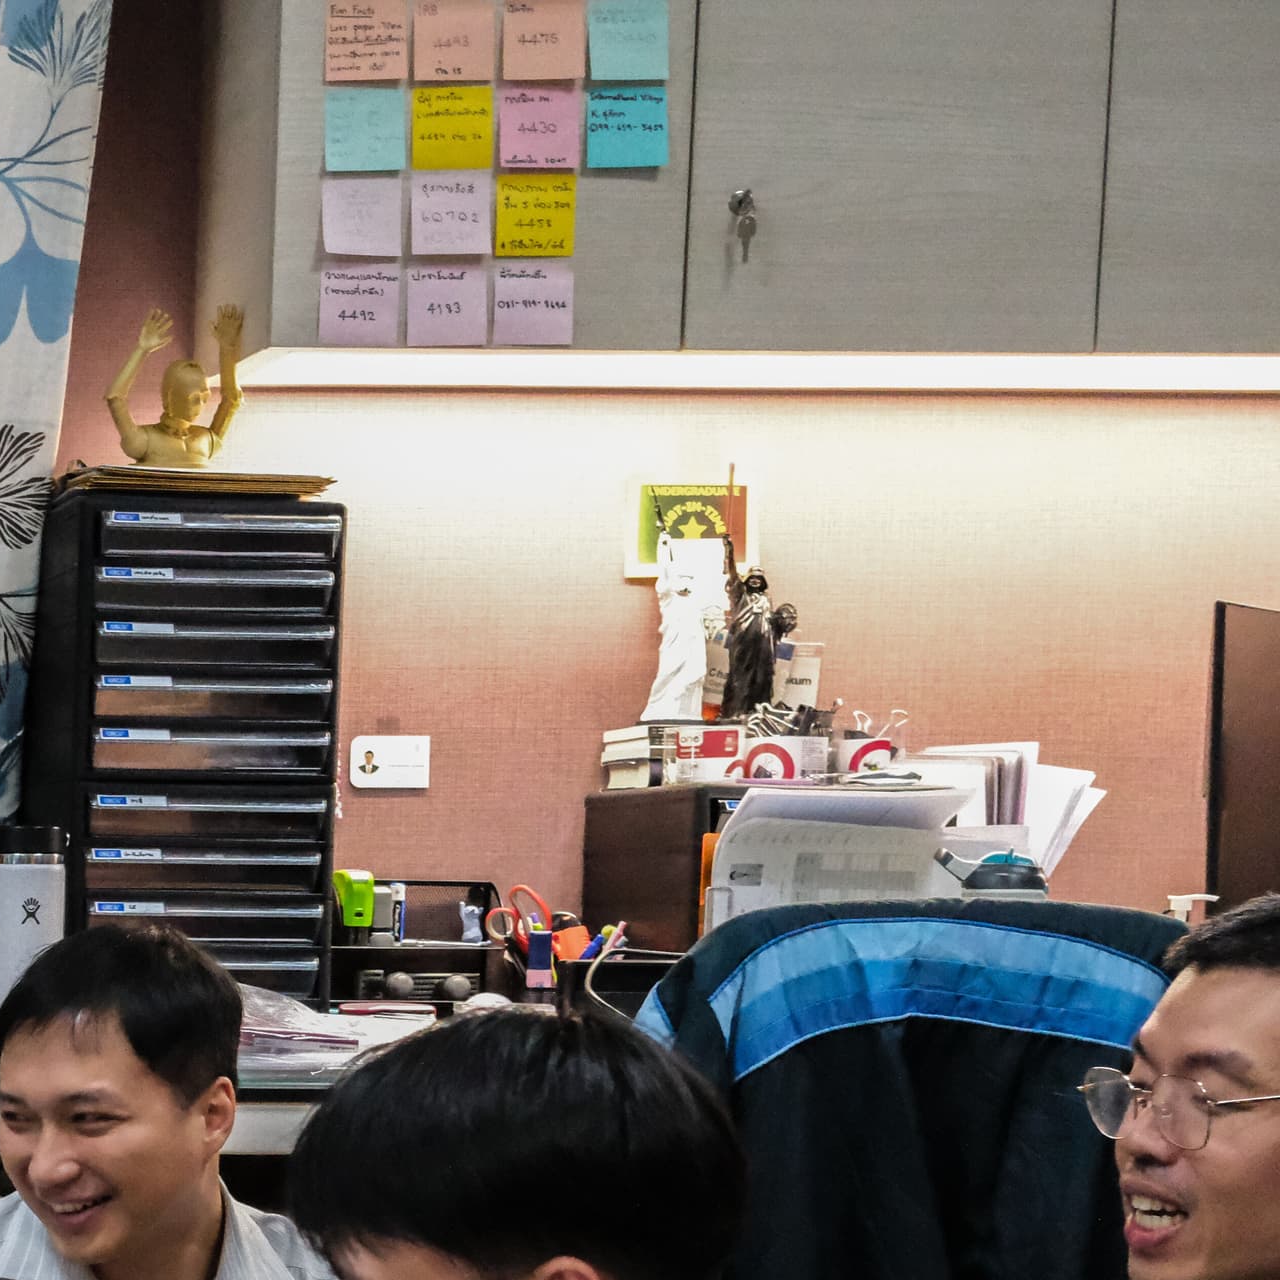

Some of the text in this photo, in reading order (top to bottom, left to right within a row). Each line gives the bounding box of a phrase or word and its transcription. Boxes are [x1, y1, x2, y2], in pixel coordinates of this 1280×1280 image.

[518, 32, 558, 46] 4475
[517, 121, 557, 134] 4430
[337, 309, 376, 321] 4492
[648, 486, 740, 496] UNDERGRADUAE
